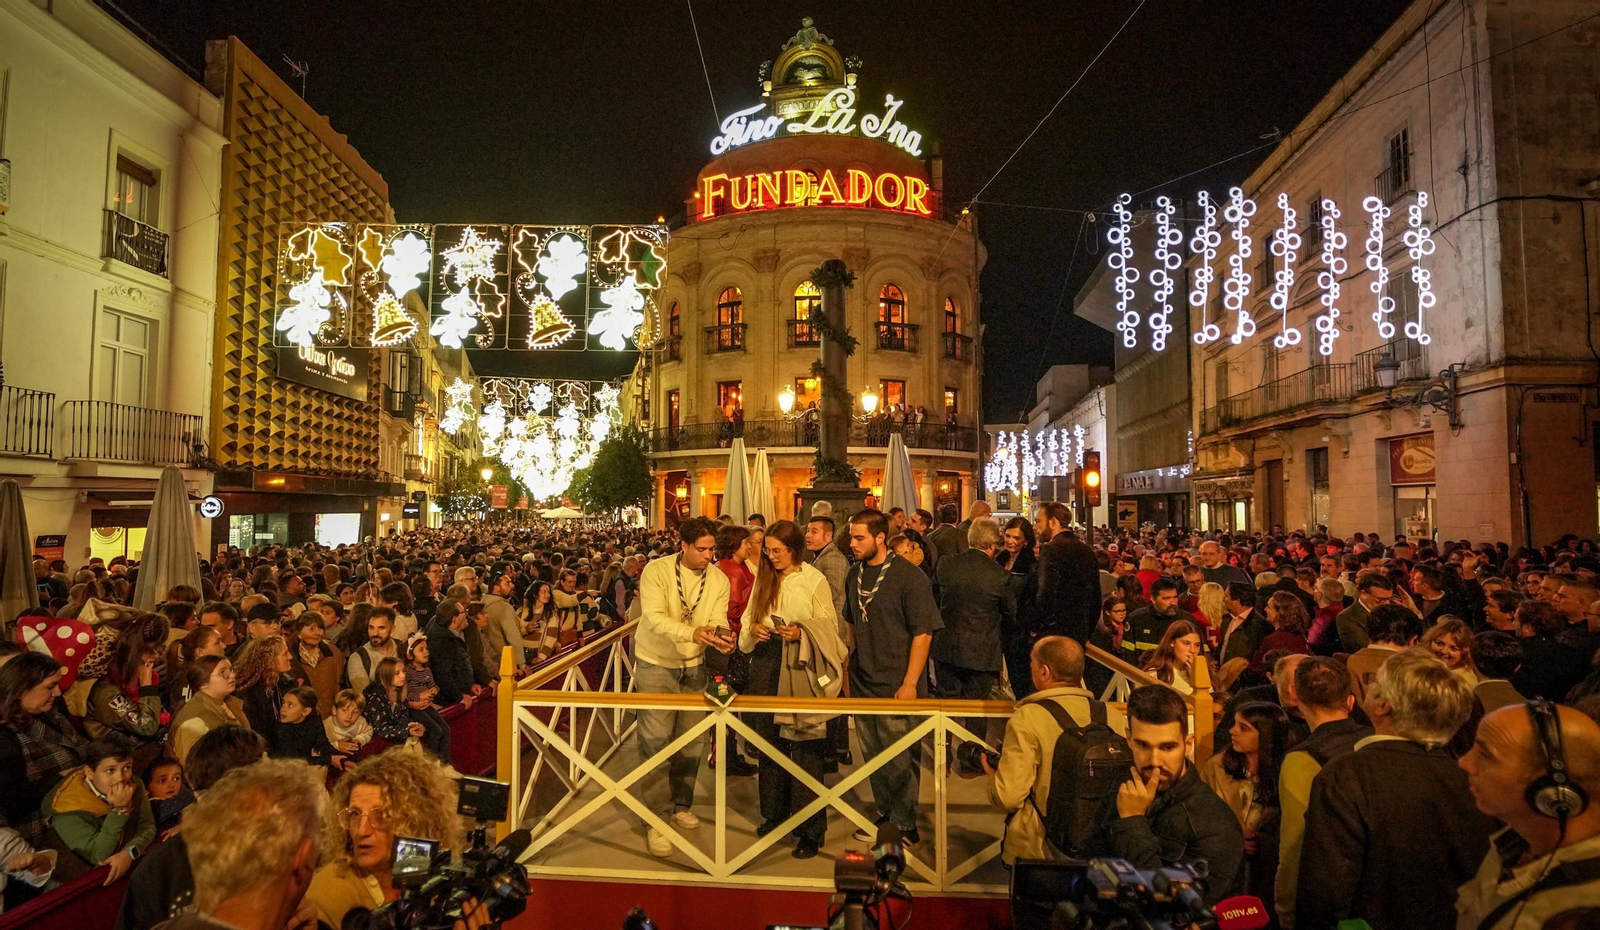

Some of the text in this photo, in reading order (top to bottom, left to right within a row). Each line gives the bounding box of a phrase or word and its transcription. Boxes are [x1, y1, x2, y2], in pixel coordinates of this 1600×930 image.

[710, 87, 922, 156] Fino La Ina
[702, 169, 932, 218] FUNDADOR
[1222, 906, 1259, 920] 101tv.es
